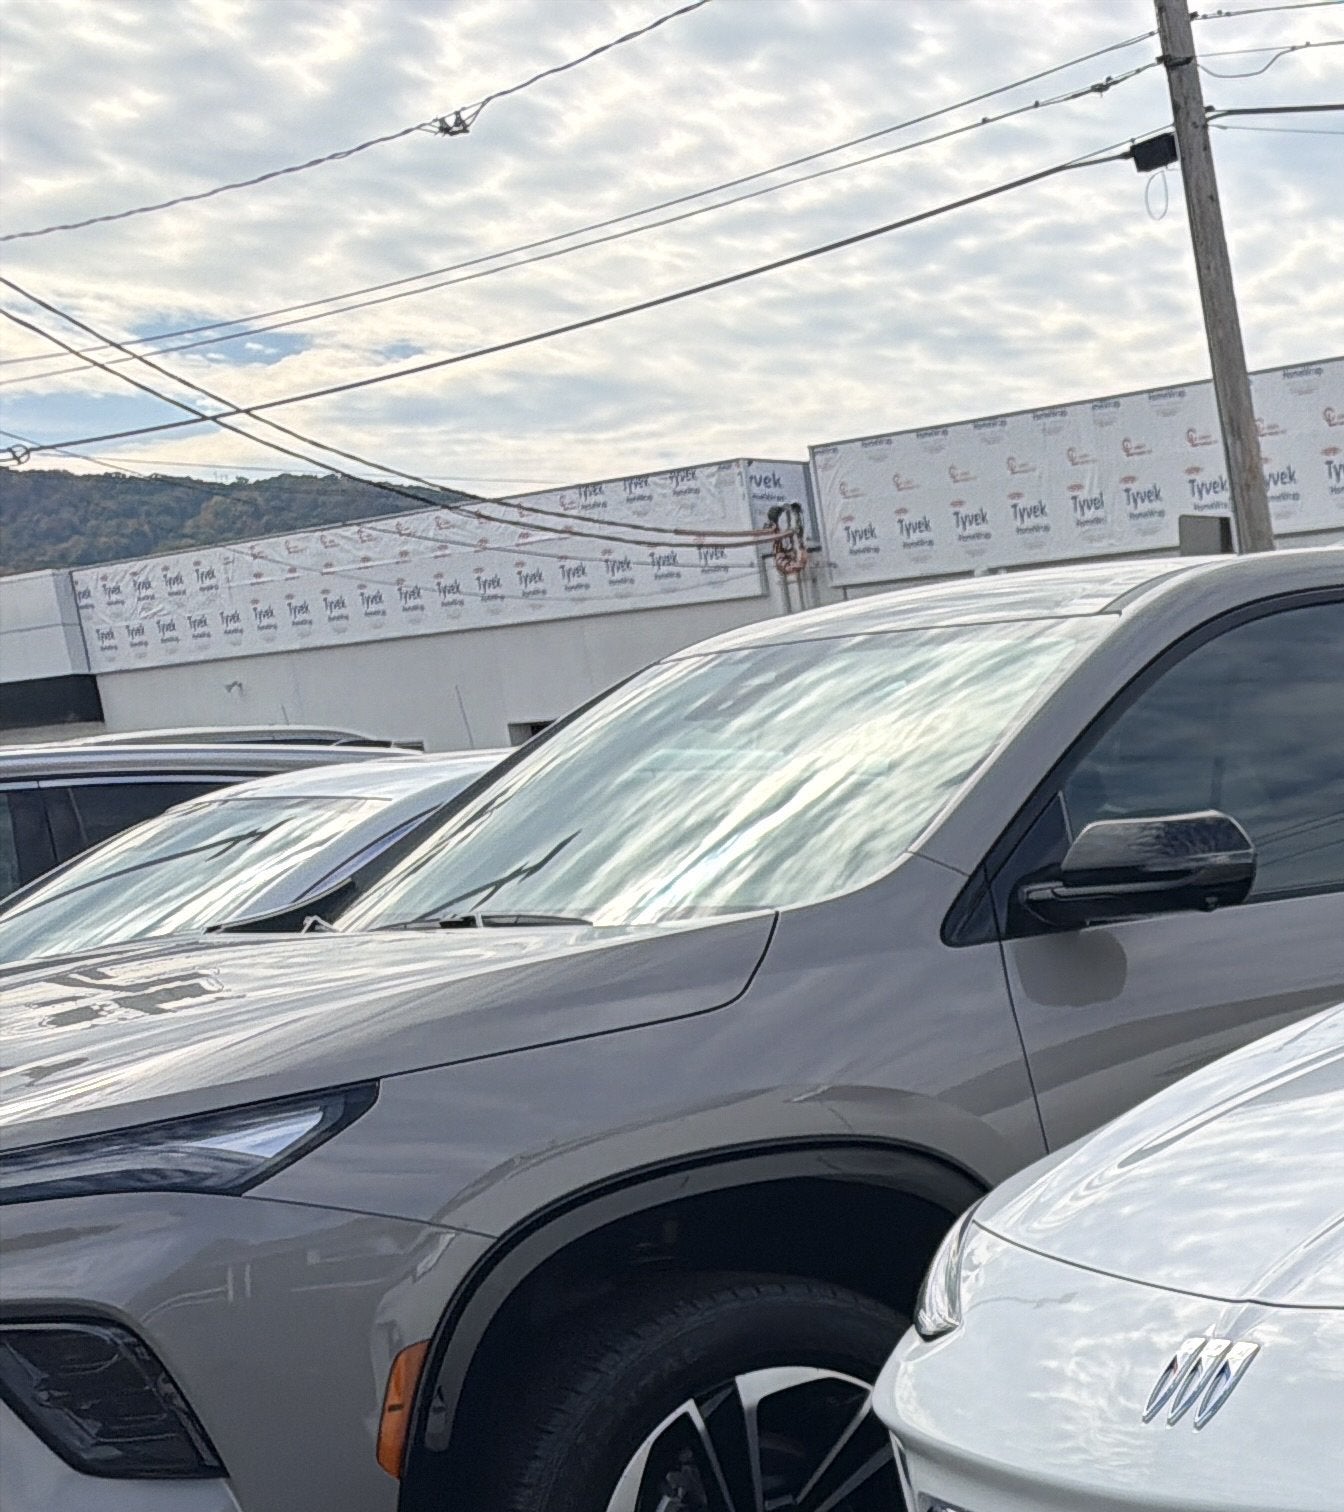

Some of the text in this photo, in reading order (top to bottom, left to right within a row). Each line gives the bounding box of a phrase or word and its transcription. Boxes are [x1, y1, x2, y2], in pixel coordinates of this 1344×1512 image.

[1263, 466, 1298, 494] yvek
[1123, 484, 1164, 511] Tyvek
[952, 508, 989, 533] Tyvek
[1010, 500, 1048, 526] Tyvek
[844, 523, 878, 547] Tyvek
[897, 516, 932, 540] Tyvek
